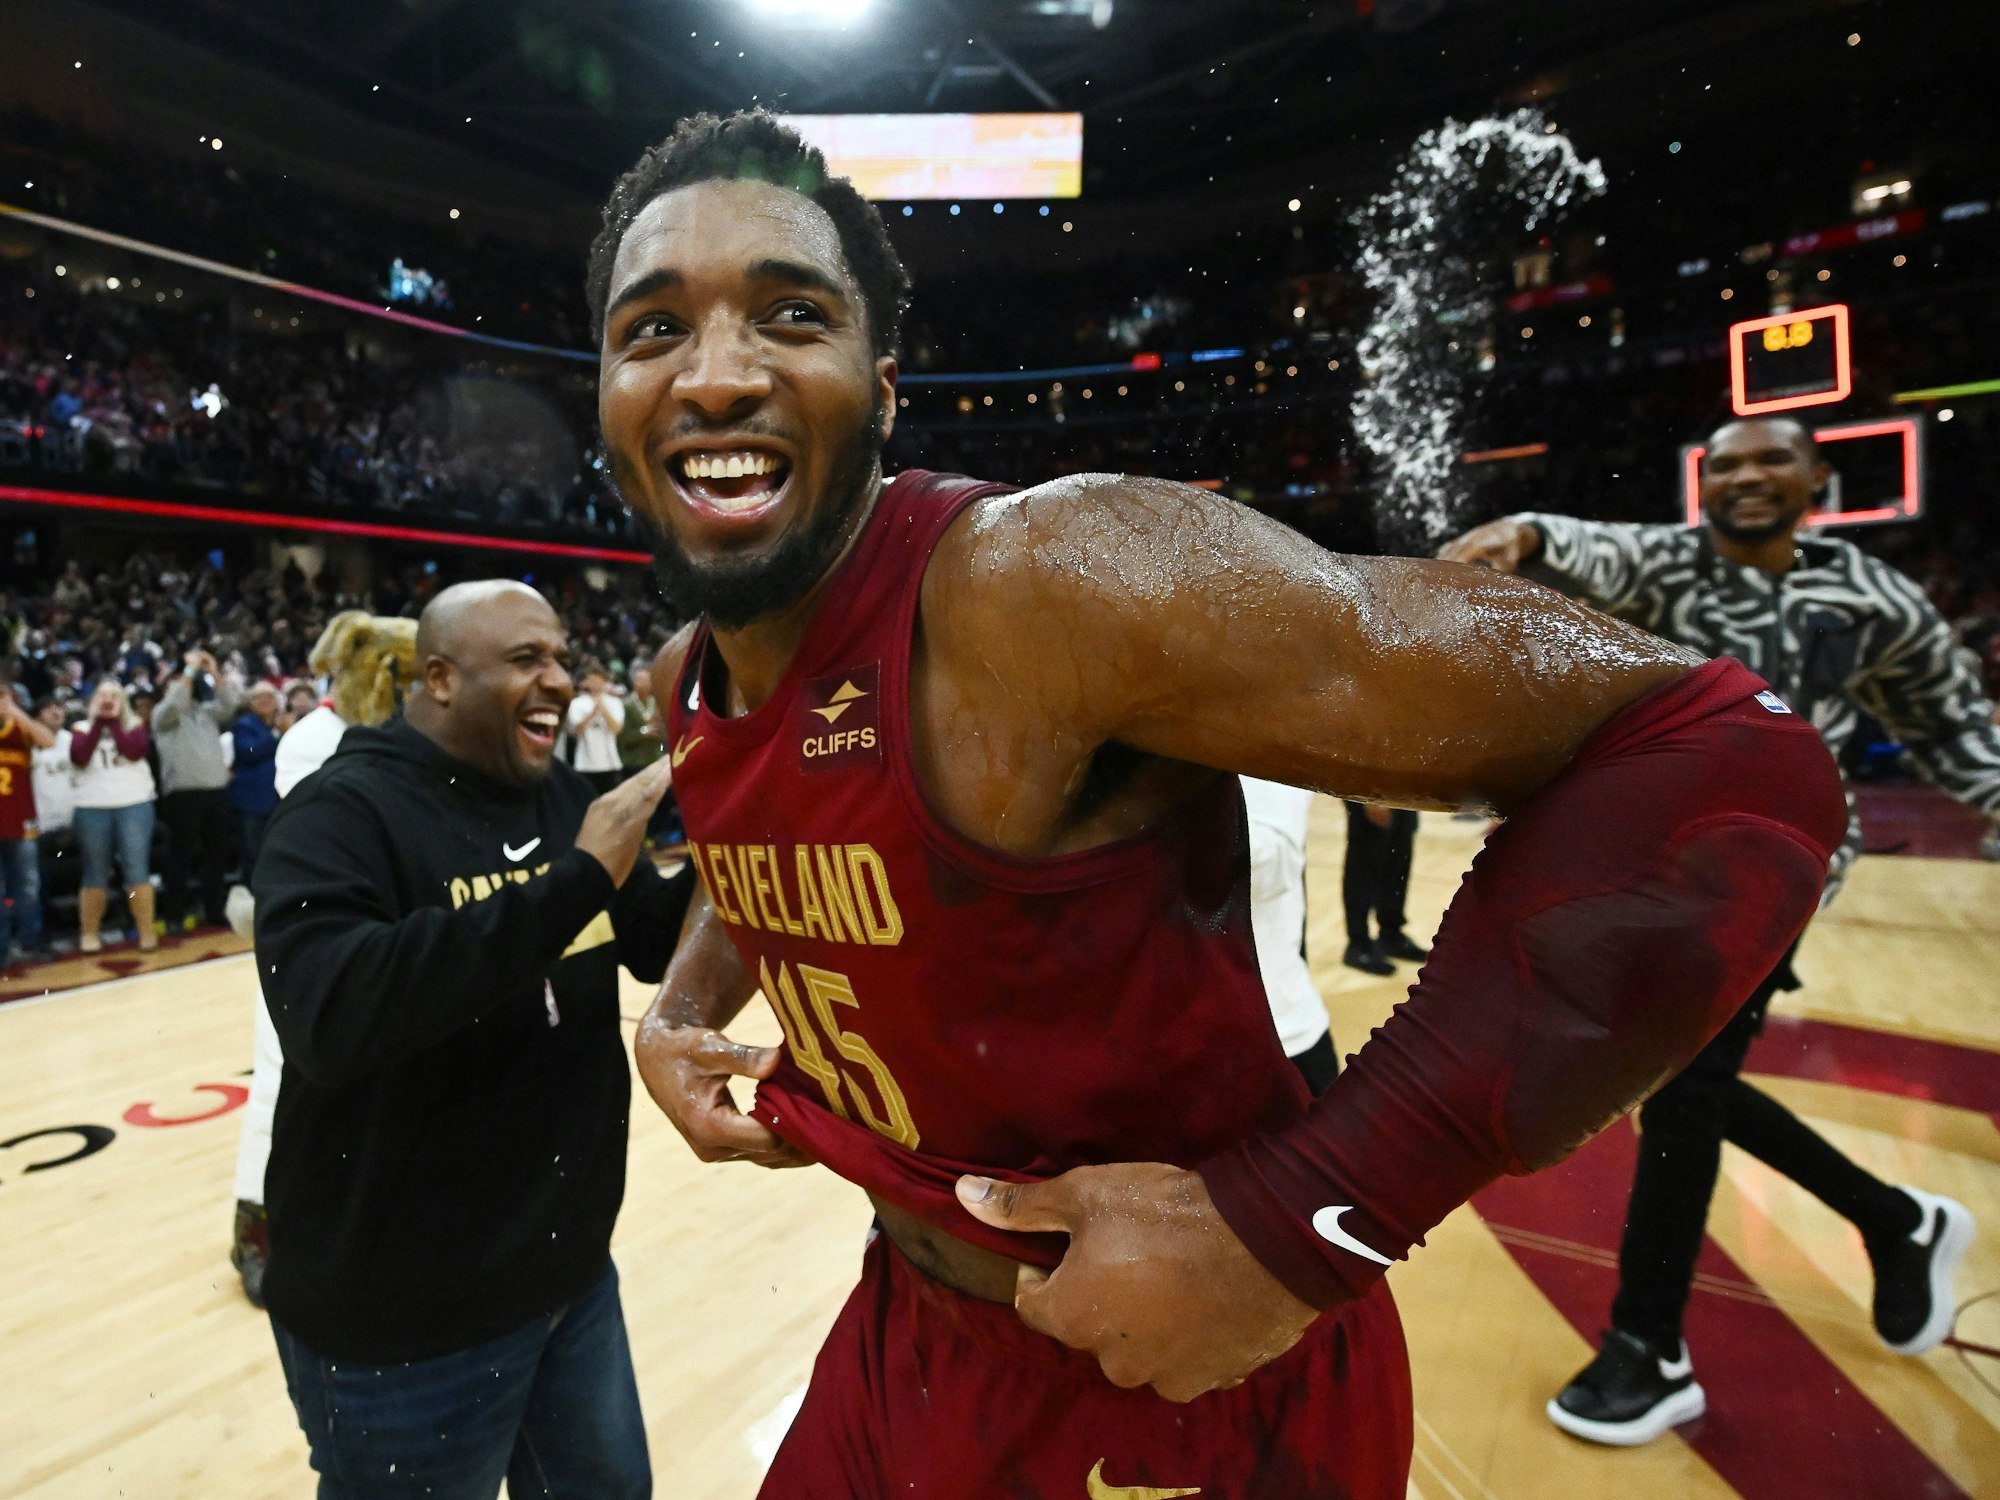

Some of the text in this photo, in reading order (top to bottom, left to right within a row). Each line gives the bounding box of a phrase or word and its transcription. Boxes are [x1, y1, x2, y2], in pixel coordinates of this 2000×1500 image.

[802, 727, 876, 759] CLIFFS
[688, 838, 904, 946] LEVELAND
[760, 955, 920, 1151] 45
